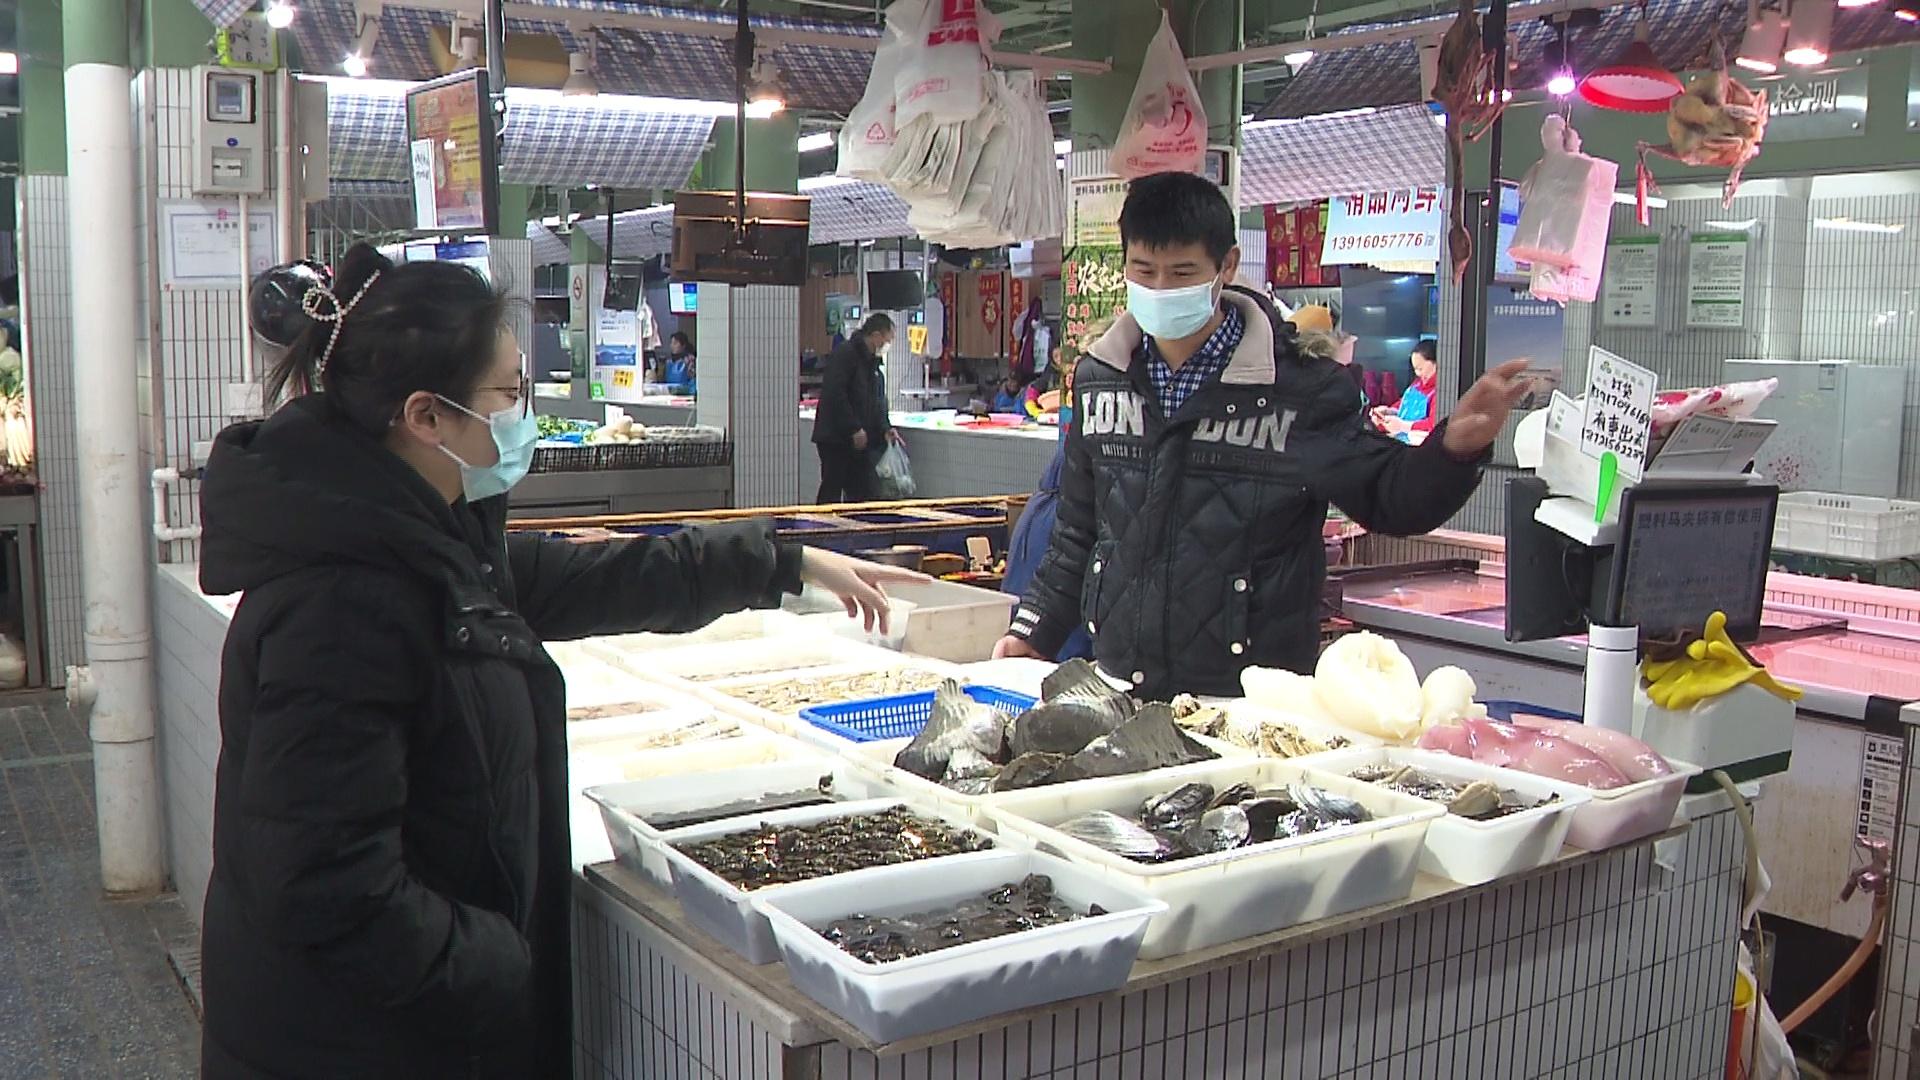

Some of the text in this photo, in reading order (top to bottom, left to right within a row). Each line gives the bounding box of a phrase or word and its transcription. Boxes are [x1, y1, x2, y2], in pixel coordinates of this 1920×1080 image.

[245, 51, 253, 62] 6
[1332, 233, 1424, 251] 13916057776
[1081, 391, 1146, 437] LON
